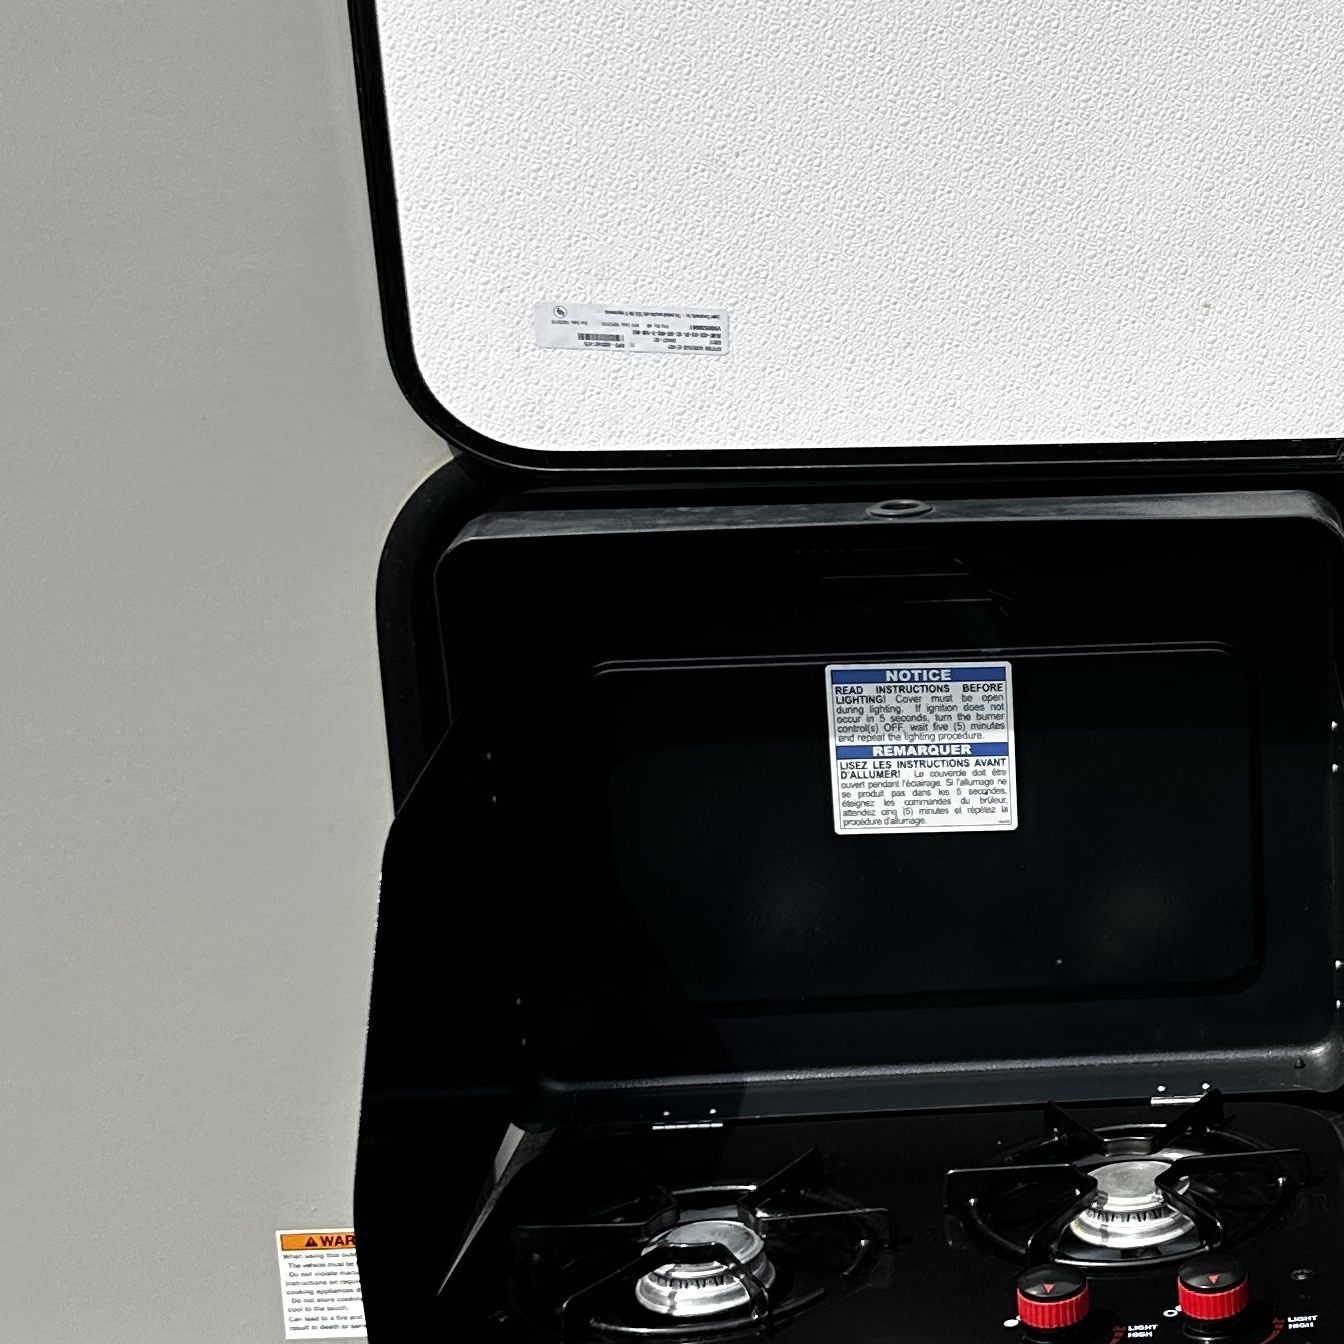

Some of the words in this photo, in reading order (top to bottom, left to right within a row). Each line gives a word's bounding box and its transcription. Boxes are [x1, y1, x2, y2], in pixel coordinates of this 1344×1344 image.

[886, 670, 951, 681] NOTICE
[835, 685, 863, 695] READ
[876, 685, 950, 694] INSTRUCTIONS
[963, 683, 1003, 692] BEFORE
[836, 695, 886, 704] LIGHTING!
[895, 695, 922, 703] Cover
[962, 694, 973, 702] be
[982, 694, 1004, 703] open
[836, 705, 864, 715] during
[869, 705, 904, 714] lighting.
[927, 703, 957, 713] ignition
[964, 703, 985, 711] does
[991, 703, 1004, 711] not
[879, 714, 885, 722] 5
[958, 713, 971, 721] the
[976, 712, 1005, 720] burner
[838, 724, 879, 734] control(s)
[910, 723, 929, 731] wait
[933, 722, 949, 730] five
[953, 722, 966, 731] (5)
[971, 722, 1005, 730] minutes
[838, 733, 854, 742] and
[857, 734, 886, 743] repeat
[888, 733, 901, 741] the
[904, 732, 935, 743] lighting
[938, 732, 984, 742] procedure.
[873, 745, 971, 756] REMARQUER
[840, 762, 867, 770] LISEZ
[873, 761, 891, 769] LES
[897, 759, 970, 768] INSTRUCTIONS
[974, 758, 1006, 766] AVANT
[840, 770, 900, 779] D'ALLUMER!
[1287, 1314, 1318, 1323] LIGHT
